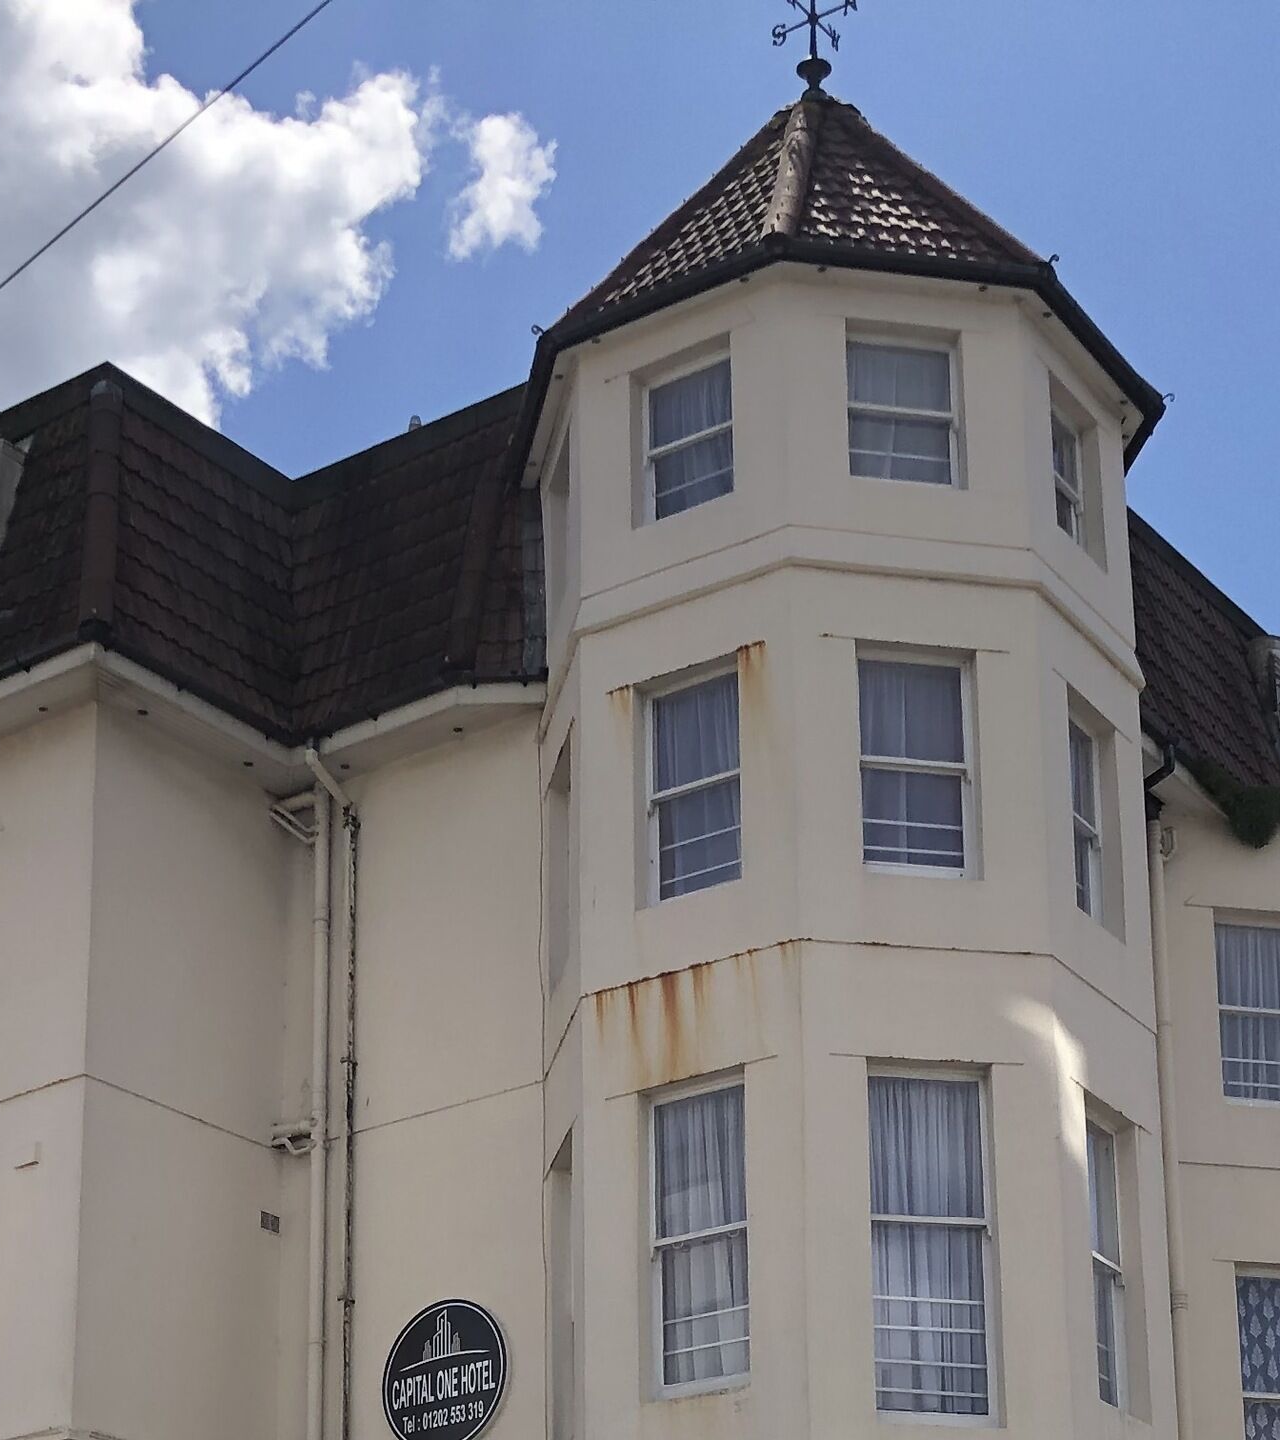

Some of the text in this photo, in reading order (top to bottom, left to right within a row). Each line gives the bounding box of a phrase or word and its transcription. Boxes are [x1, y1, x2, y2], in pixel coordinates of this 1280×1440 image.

[392, 1359, 495, 1410] CAPITAL ONE HOTEL
[422, 1409, 448, 1430] 01202
[450, 1404, 466, 1424] 553
[468, 1400, 484, 1420] 319
